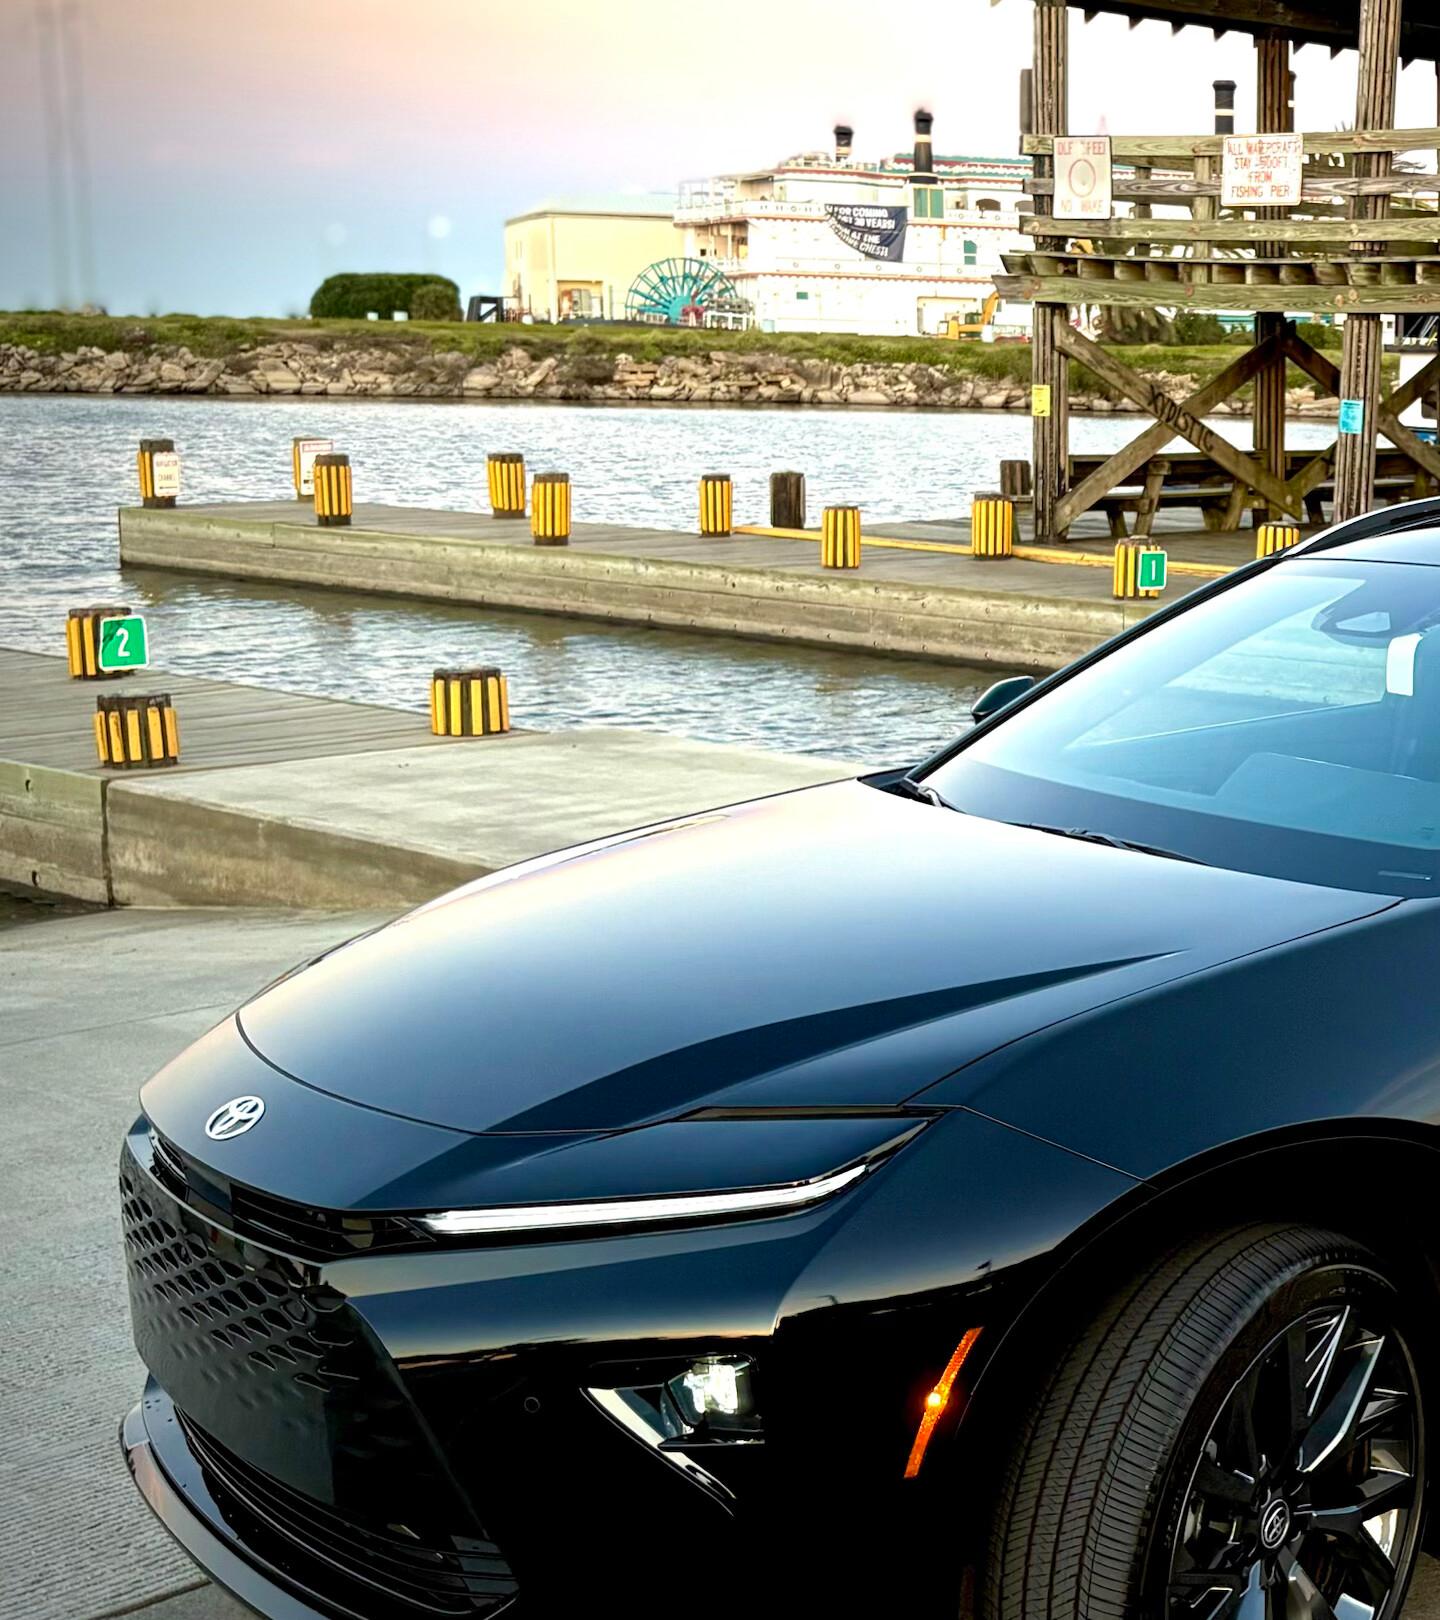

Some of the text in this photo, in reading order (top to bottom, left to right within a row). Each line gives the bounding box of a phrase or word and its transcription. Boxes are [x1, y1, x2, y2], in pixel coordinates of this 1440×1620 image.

[1231, 185, 1290, 198] FISHING PIER
[1151, 559, 1156, 581] 1
[116, 627, 131, 657] 2
